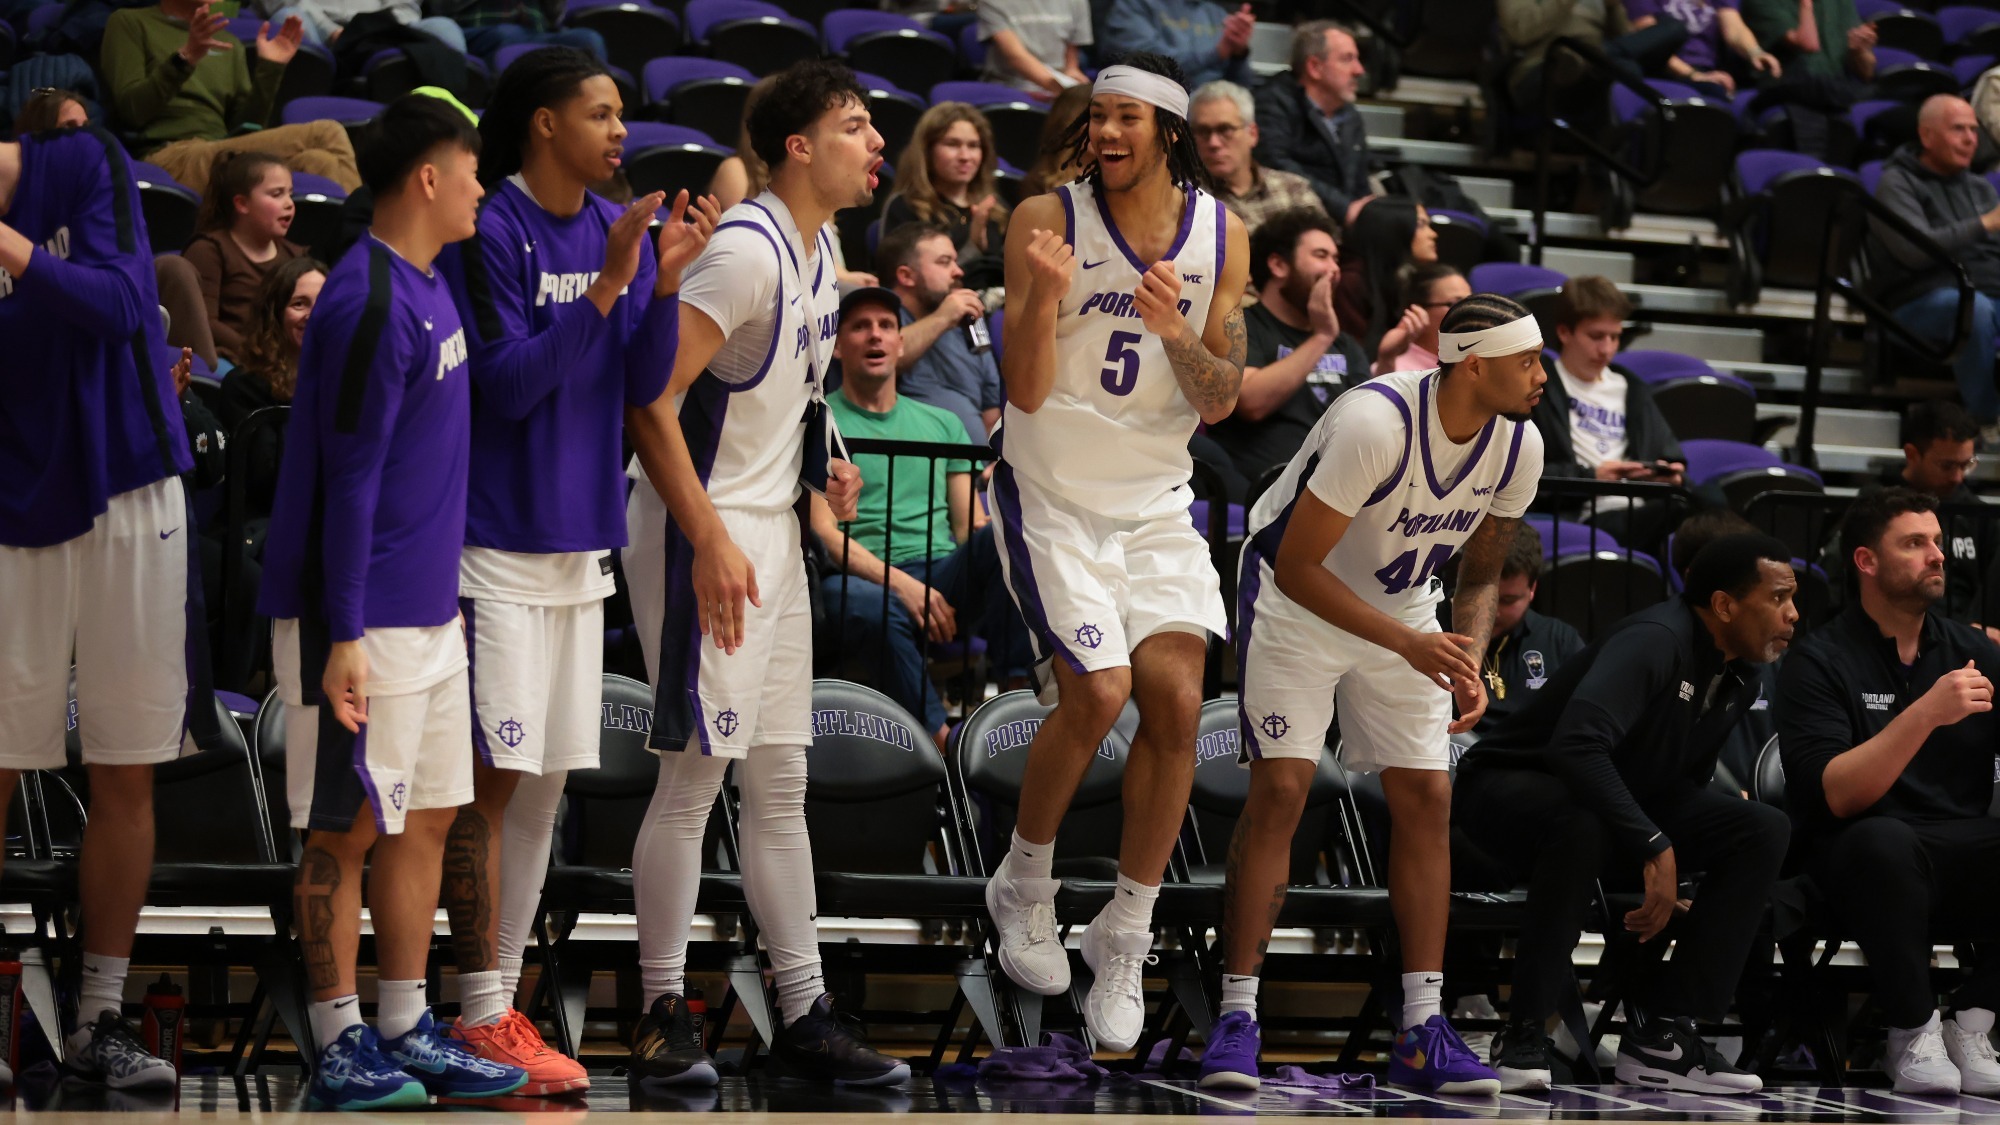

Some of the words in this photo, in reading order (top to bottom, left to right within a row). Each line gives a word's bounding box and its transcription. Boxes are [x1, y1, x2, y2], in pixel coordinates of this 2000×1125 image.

[1182, 273, 1204, 284] WCC
[1100, 330, 1142, 396] 5
[811, 709, 913, 752] RTLAND
[1195, 728, 1239, 768] PORT
